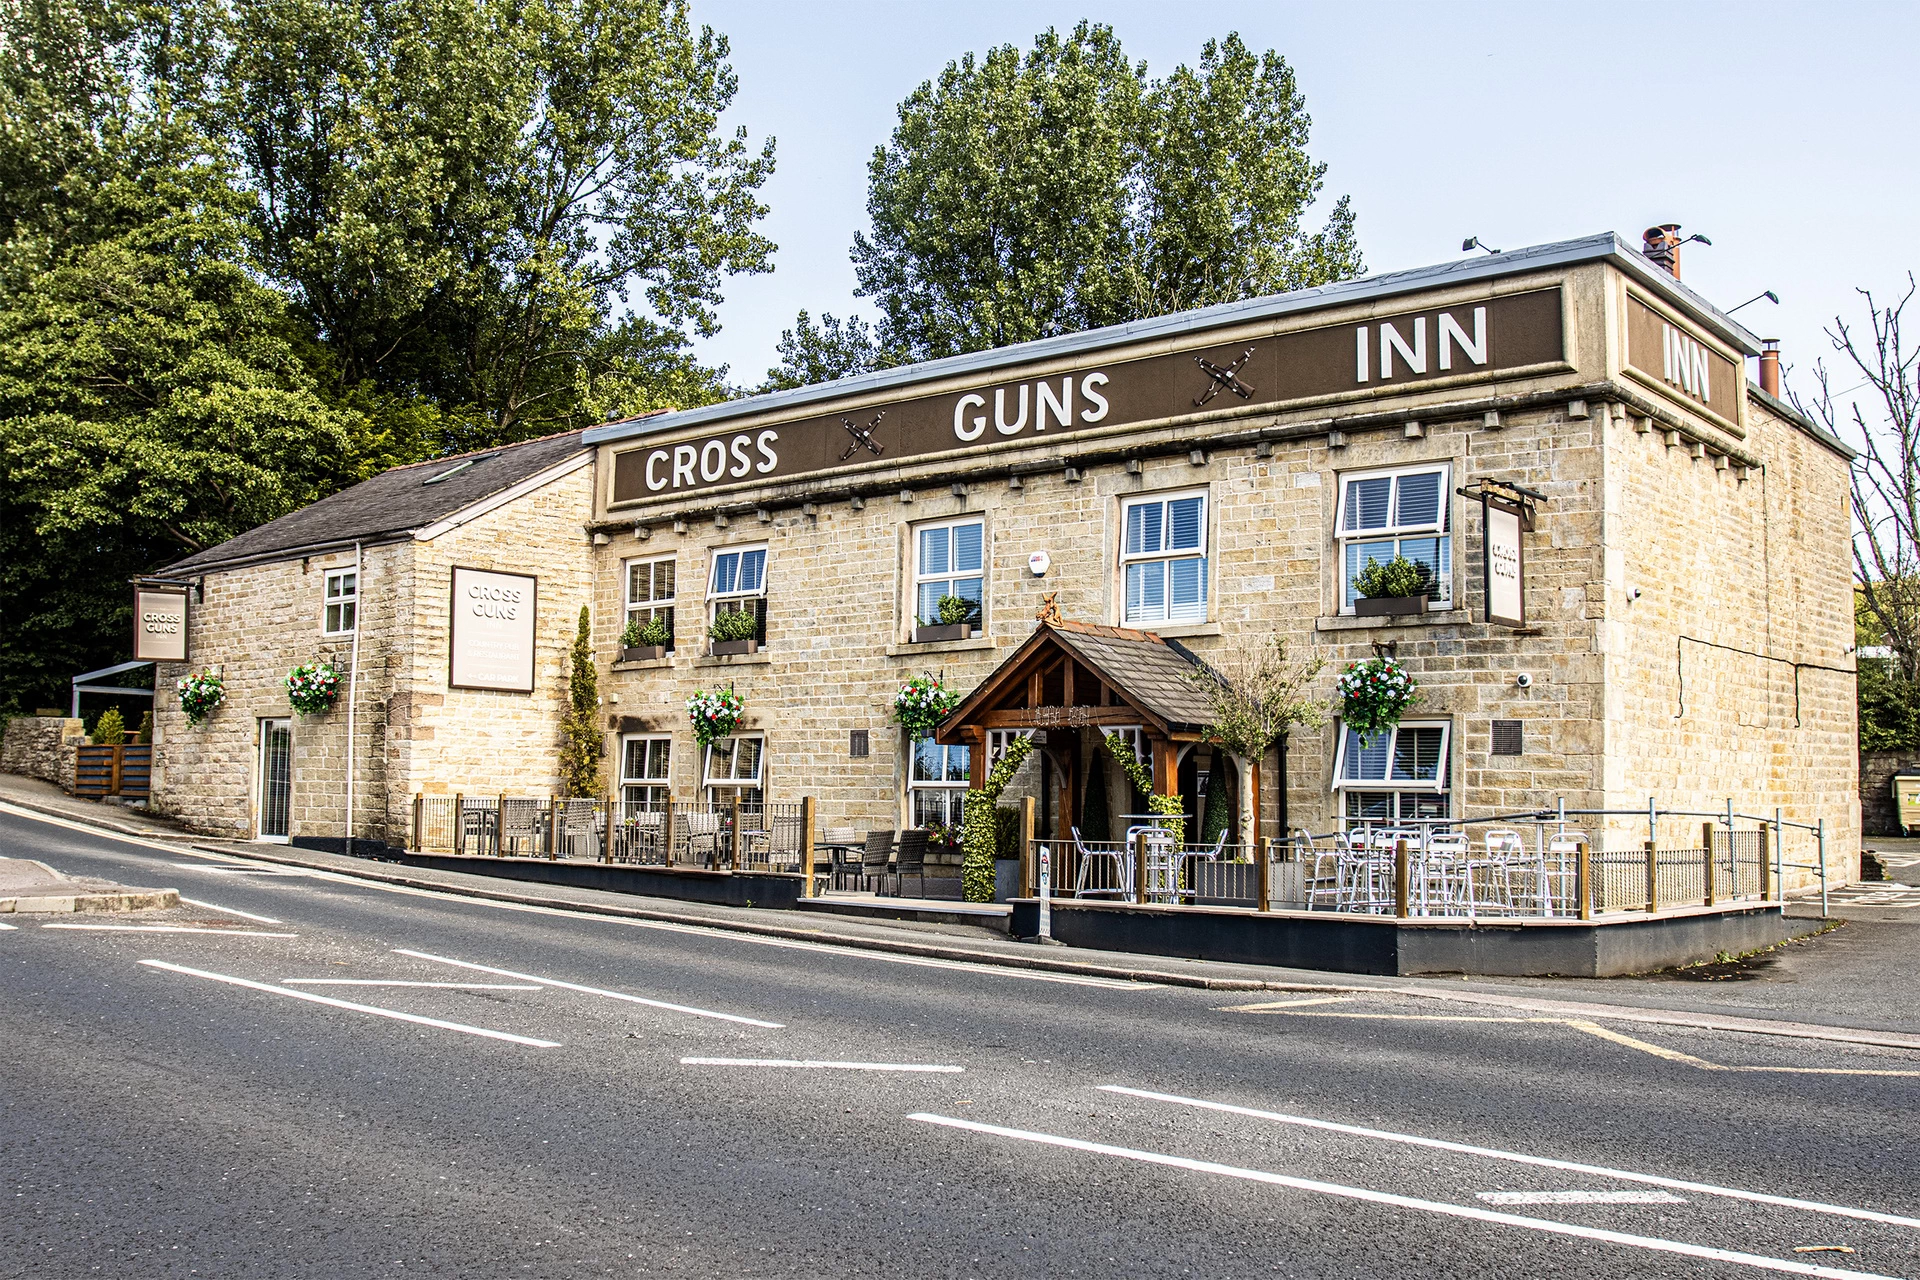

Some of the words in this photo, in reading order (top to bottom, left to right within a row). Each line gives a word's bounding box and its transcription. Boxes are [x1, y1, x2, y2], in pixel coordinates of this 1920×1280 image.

[1661, 323, 1711, 403] INN
[644, 429, 779, 492] CROSS
[953, 371, 1110, 443] GUNS
[1355, 306, 1488, 383] INN
[468, 584, 522, 603] CROSS
[143, 613, 180, 624] CROSS
[472, 603, 518, 620] GUNS
[146, 624, 177, 634] GUNS
[478, 672, 496, 681] CAR
[497, 674, 520, 683] PARK
